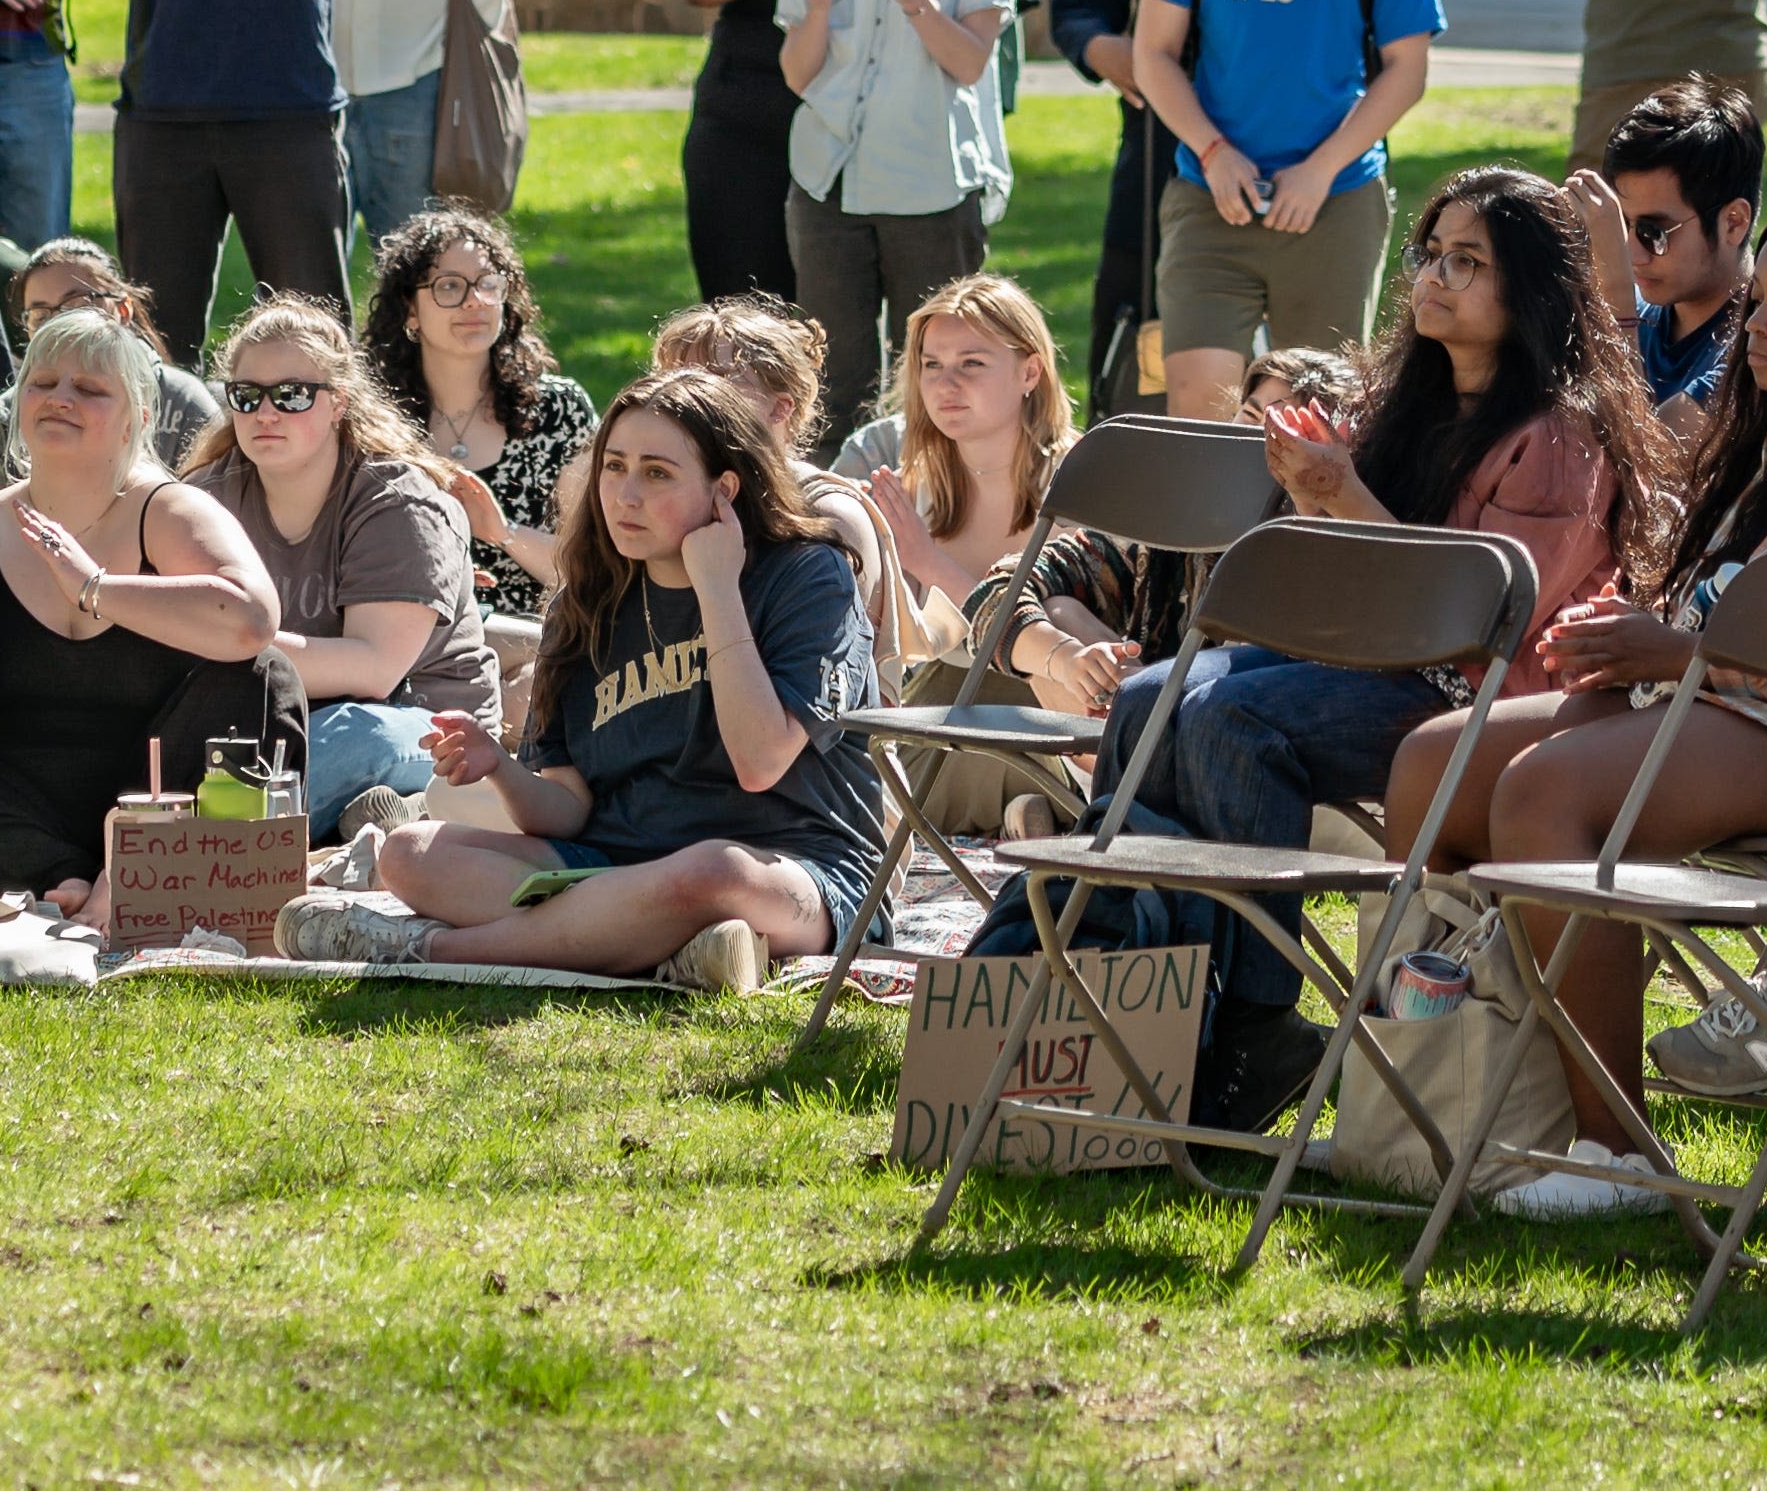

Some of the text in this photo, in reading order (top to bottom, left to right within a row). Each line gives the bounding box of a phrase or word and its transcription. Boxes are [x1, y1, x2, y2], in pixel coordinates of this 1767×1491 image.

[117, 828, 189, 855] End
[196, 833, 248, 855] the
[119, 861, 306, 891] War Machine!
[115, 903, 170, 929] Free
[922, 948, 1198, 1031] HAMILTON
